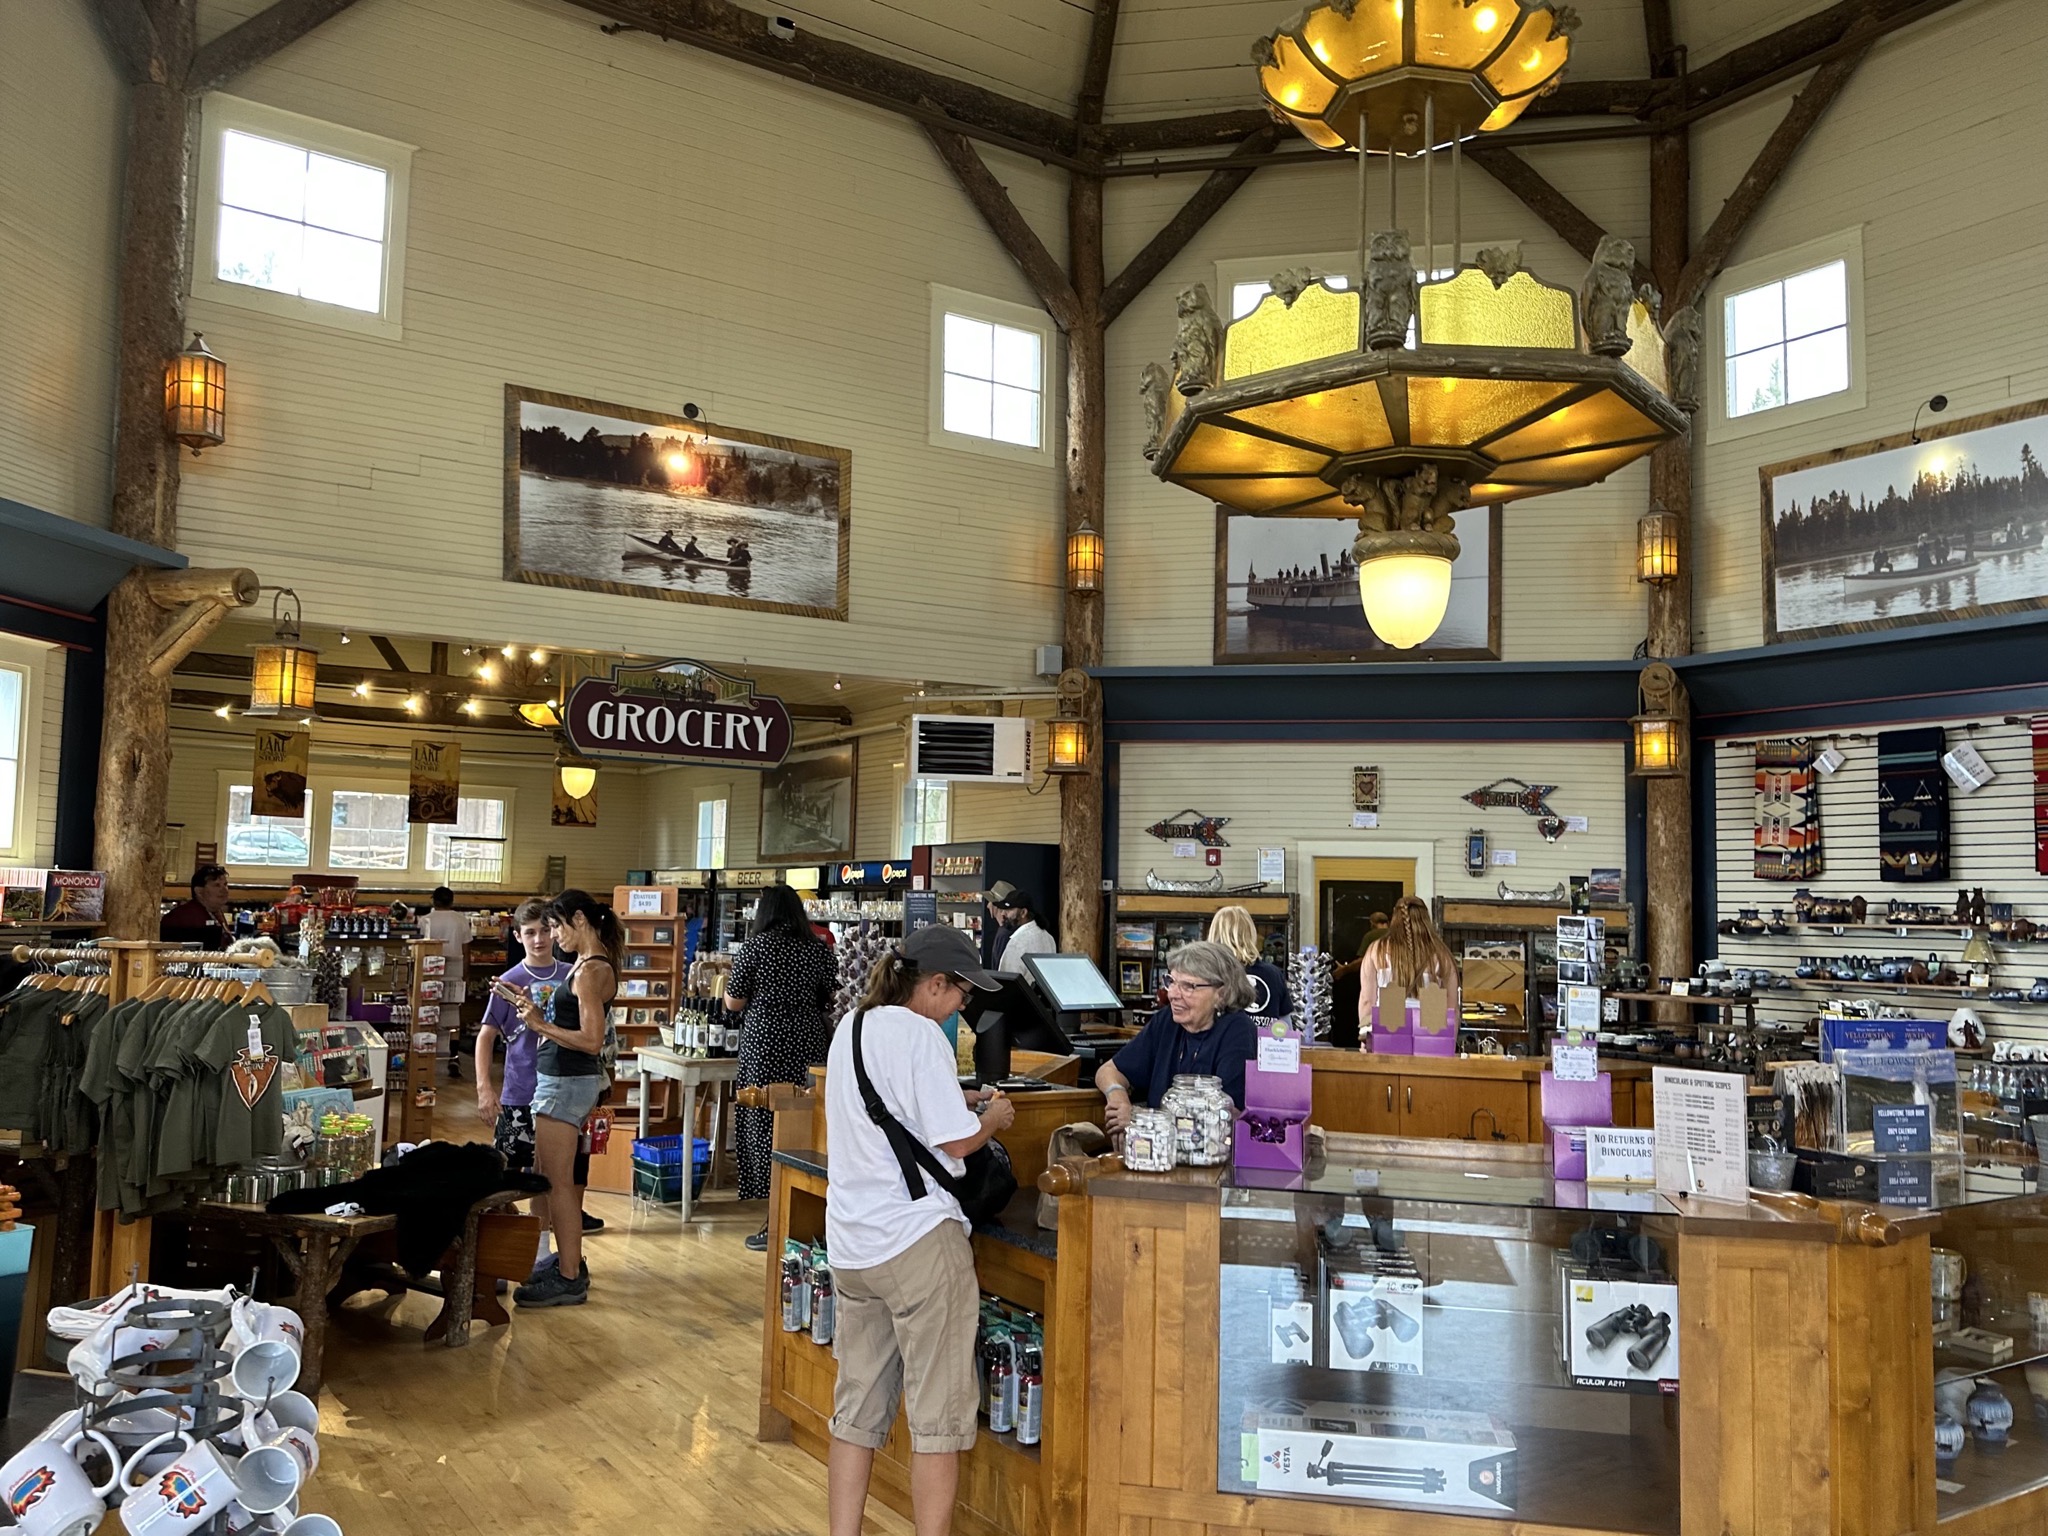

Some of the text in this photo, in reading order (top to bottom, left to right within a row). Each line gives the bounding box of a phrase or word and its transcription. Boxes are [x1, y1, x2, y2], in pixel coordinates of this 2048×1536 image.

[587, 700, 774, 753] GROCERY
[737, 871, 762, 886] BEER
[850, 868, 865, 880] pepsi
[891, 867, 907, 880] pepsi
[54, 876, 100, 886] MONOPOLY
[1845, 1031, 1895, 1039] YELLOWSTONE
[322, 1050, 351, 1060] BABIES
[1859, 1055, 1938, 1067] YELLOWSTONE
[1664, 1076, 1690, 1086] BINOCULARS
[1694, 1079, 1714, 1088] SPOTTING
[1714, 1081, 1731, 1090] SCOPES
[1877, 1109, 1904, 1117] YELLOWSTONE
[1898, 1127, 1917, 1135] CALENDAR
[1594, 1134, 1606, 1143] NO
[1608, 1134, 1645, 1145] RETURNS
[1601, 1146, 1652, 1158] BINOCULARS
[1576, 1377, 1626, 1388] ACULON A211
[1283, 1446, 1291, 1474] VESTA
